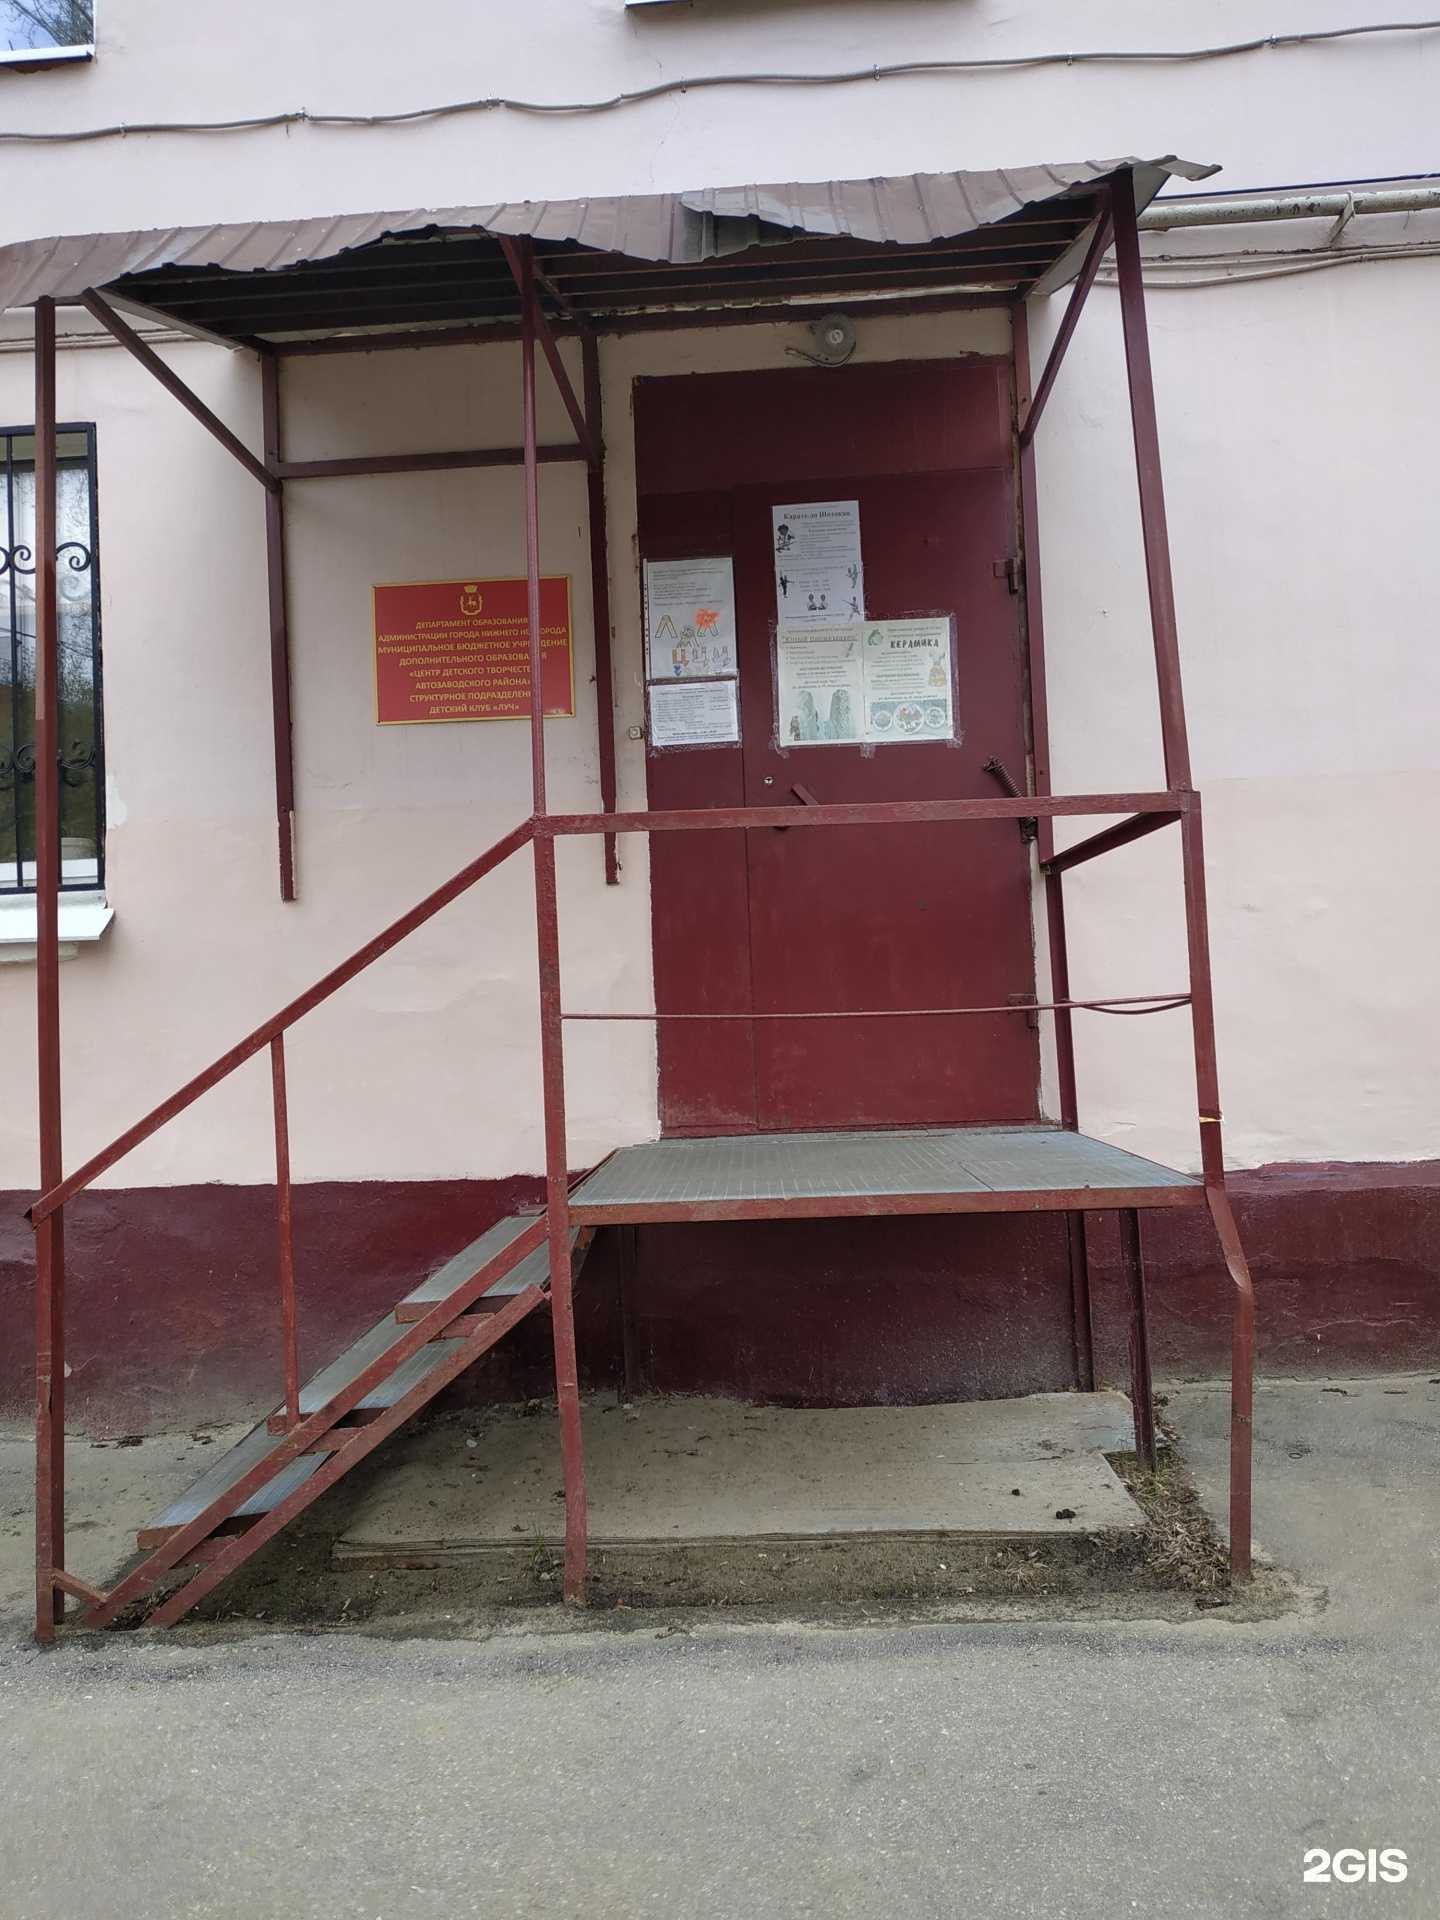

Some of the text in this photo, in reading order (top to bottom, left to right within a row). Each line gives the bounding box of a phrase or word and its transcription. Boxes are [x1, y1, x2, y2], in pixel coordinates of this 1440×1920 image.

[416, 619, 471, 630] ДЕПАРТАМЕНТ
[378, 632, 448, 642] АДМИНИСТРАЦИИ
[449, 631, 480, 639] ГОРОДА
[482, 628, 518, 638] НИЖНЕГО
[378, 639, 567, 654] МУНИЦИПАЛЬНОЕ БЮДЖЕТНОЕ УЧРДЕНИЕ
[890, 639, 939, 649] КЕРАМИКА
[399, 653, 547, 667] ДОПОЛНИТЕЛЬНОГО ОБРАЗОВАЯ
[442, 668, 484, 677] ДЕТСКОГО
[416, 679, 491, 689] АВТОЗАВОДСКОГО
[409, 691, 531, 703] СТРУКТУРНОЕ ПОДРАЗДЕЛЕН
[429, 703, 519, 714] ДЕТСКИЙ КЛУБ «ЛУЧ»
